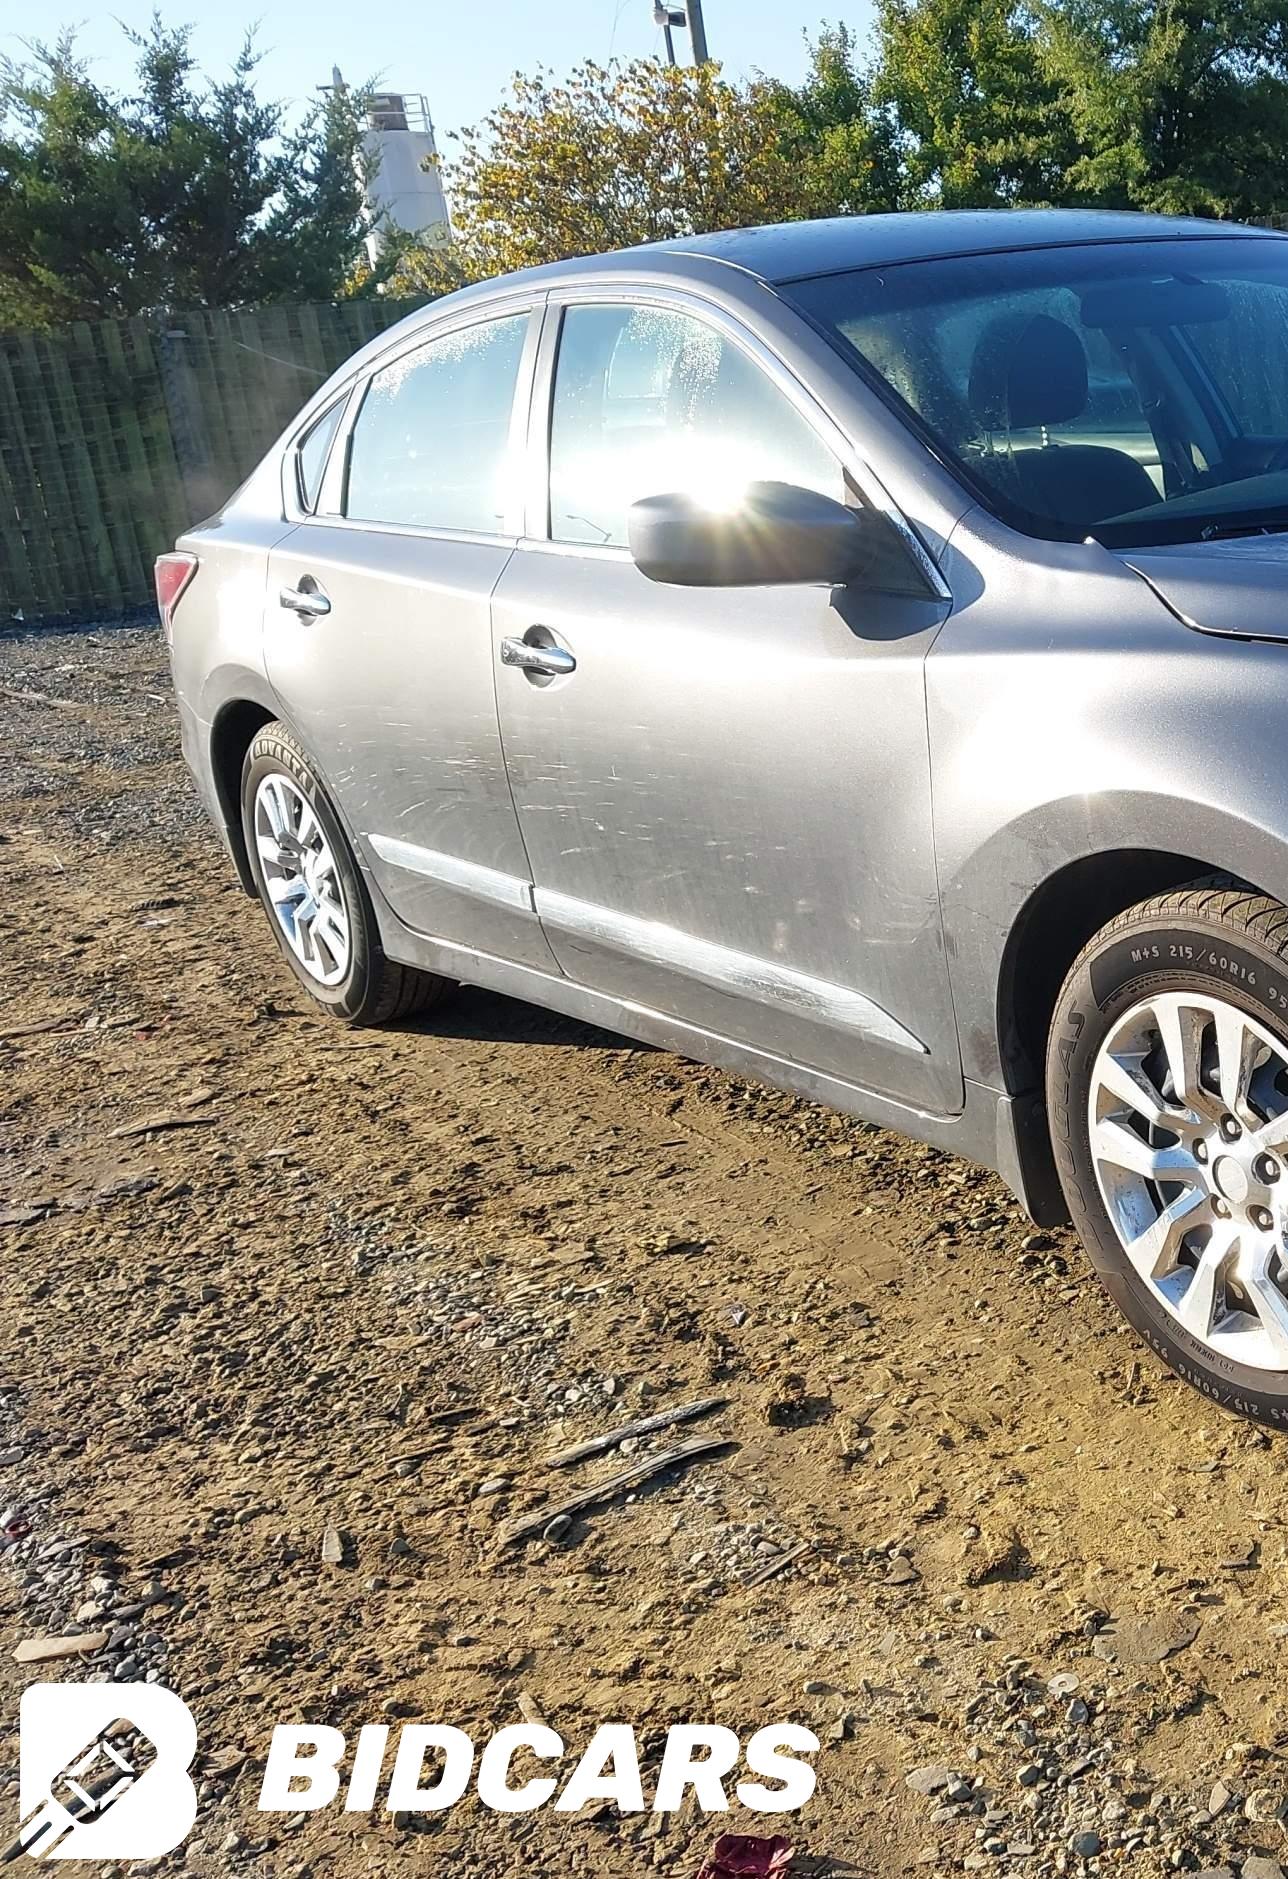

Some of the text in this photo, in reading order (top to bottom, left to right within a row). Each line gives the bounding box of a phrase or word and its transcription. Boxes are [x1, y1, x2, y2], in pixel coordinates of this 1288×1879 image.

[254, 740, 309, 789] ADVANTA
[1131, 945, 1160, 963] M+S
[1169, 945, 1256, 985] 215/60R16
[1054, 999, 1104, 1251] DOUGLAS
